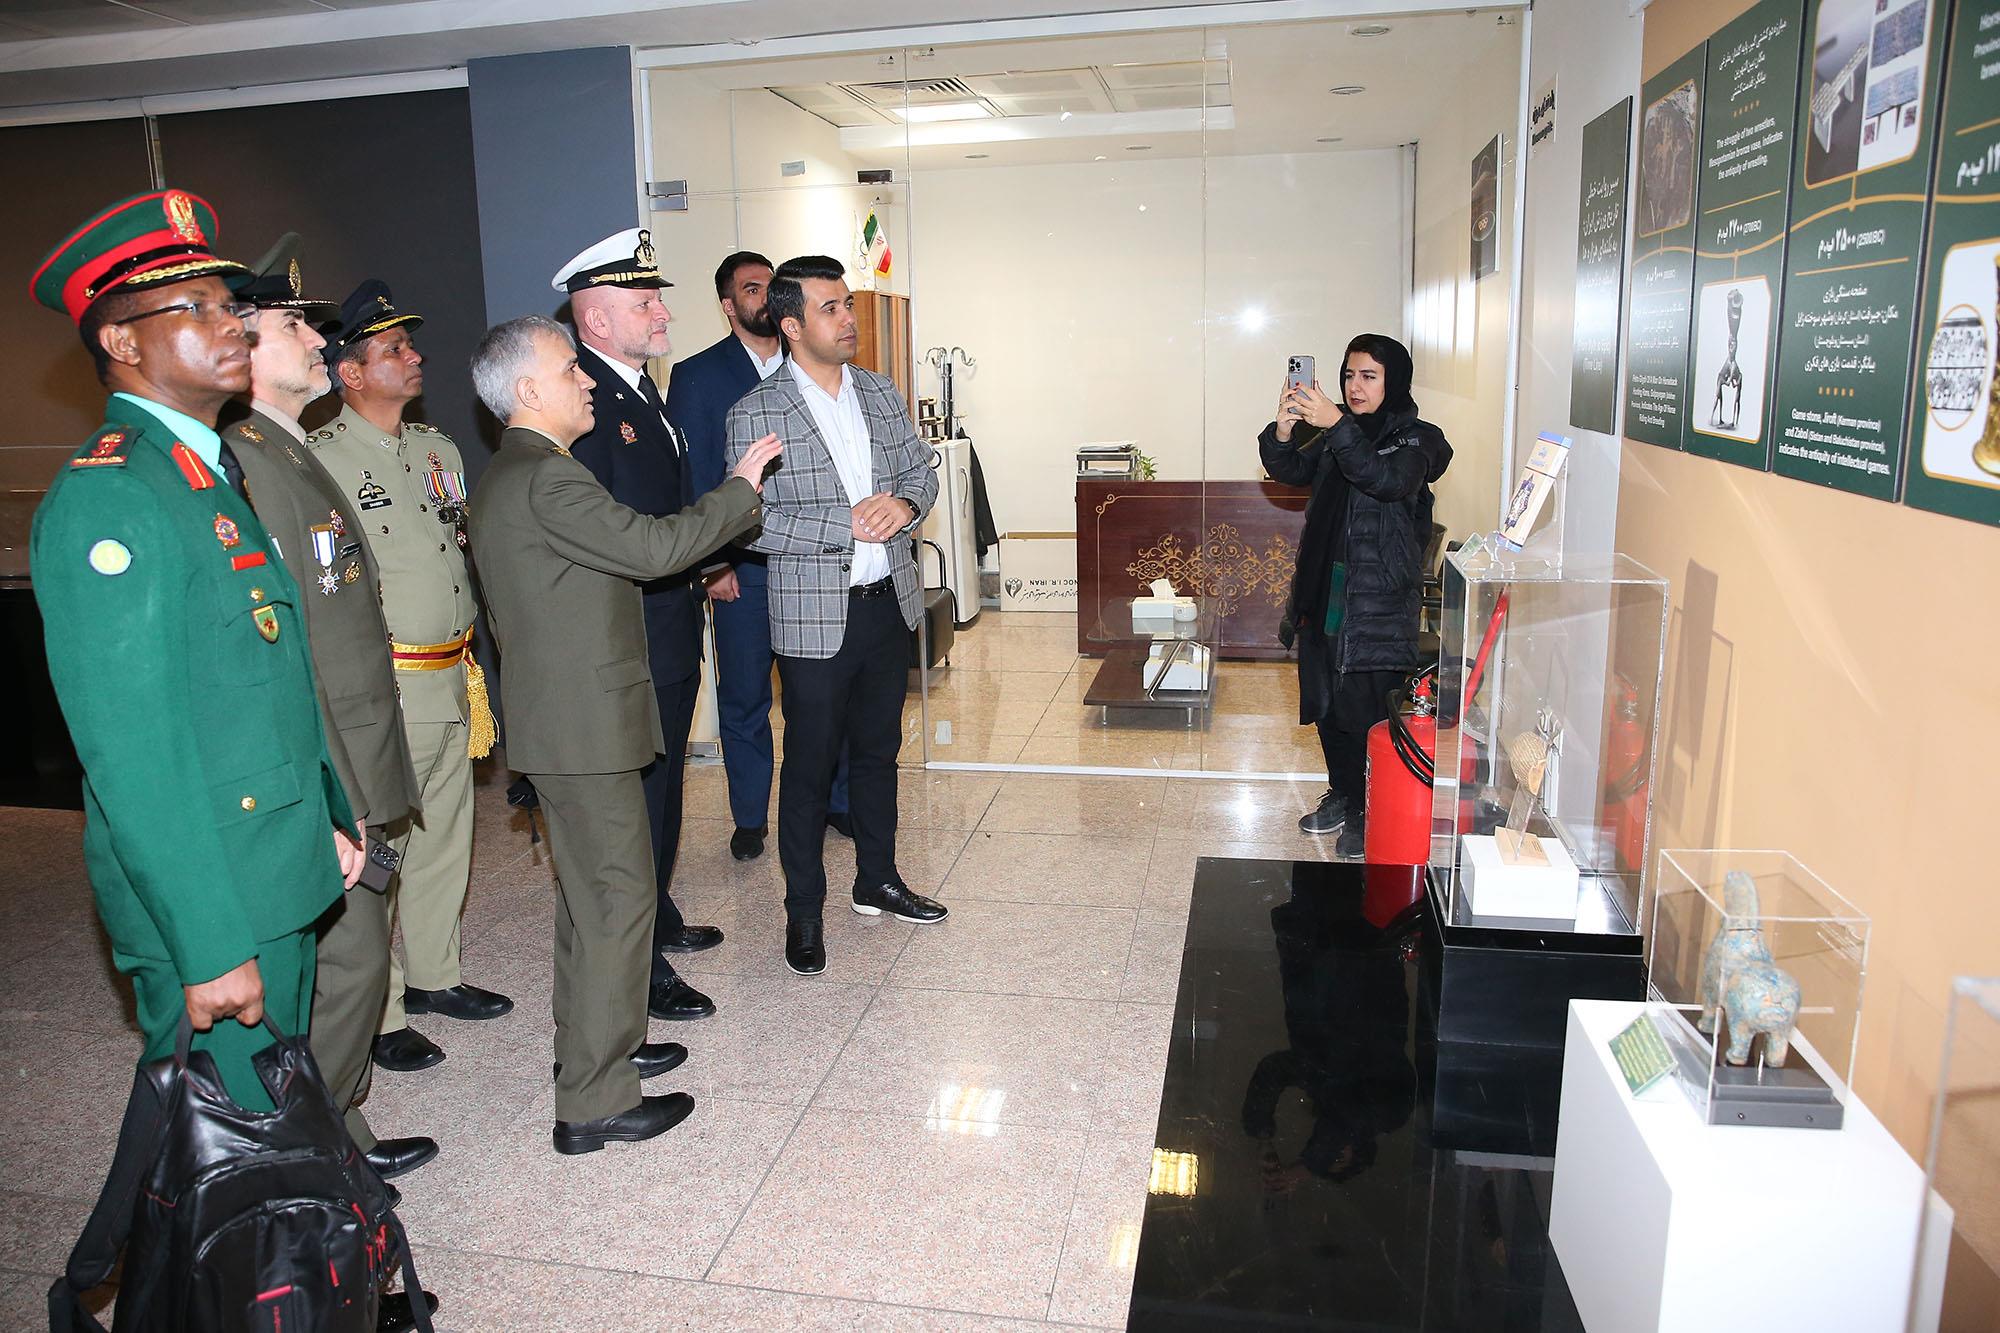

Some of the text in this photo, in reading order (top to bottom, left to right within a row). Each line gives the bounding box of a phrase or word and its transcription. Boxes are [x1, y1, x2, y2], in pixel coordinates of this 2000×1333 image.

[1724, 131, 1740, 146] struggle
[1736, 145, 1750, 157] bronze
[1762, 131, 1783, 146] indicates
[1724, 163, 1742, 177] antiquity
[1836, 227, 1856, 251] ۲۵۰۰
[1792, 408, 1806, 421] Game
[1806, 411, 1822, 425] stone,
[1822, 411, 1837, 425] Jiroft
[1856, 418, 1881, 432] province)
[1785, 427, 1794, 438] and
[1794, 427, 1808, 439] Zabol
[1808, 430, 1823, 442] (Sistan
[1824, 434, 1832, 444] and
[1778, 442, 1800, 457] indicates
[1800, 446, 1808, 458] the
[1808, 449, 1831, 466] antiquity
[1838, 453, 1868, 471] intellectual
[1868, 461, 1890, 475] games.
